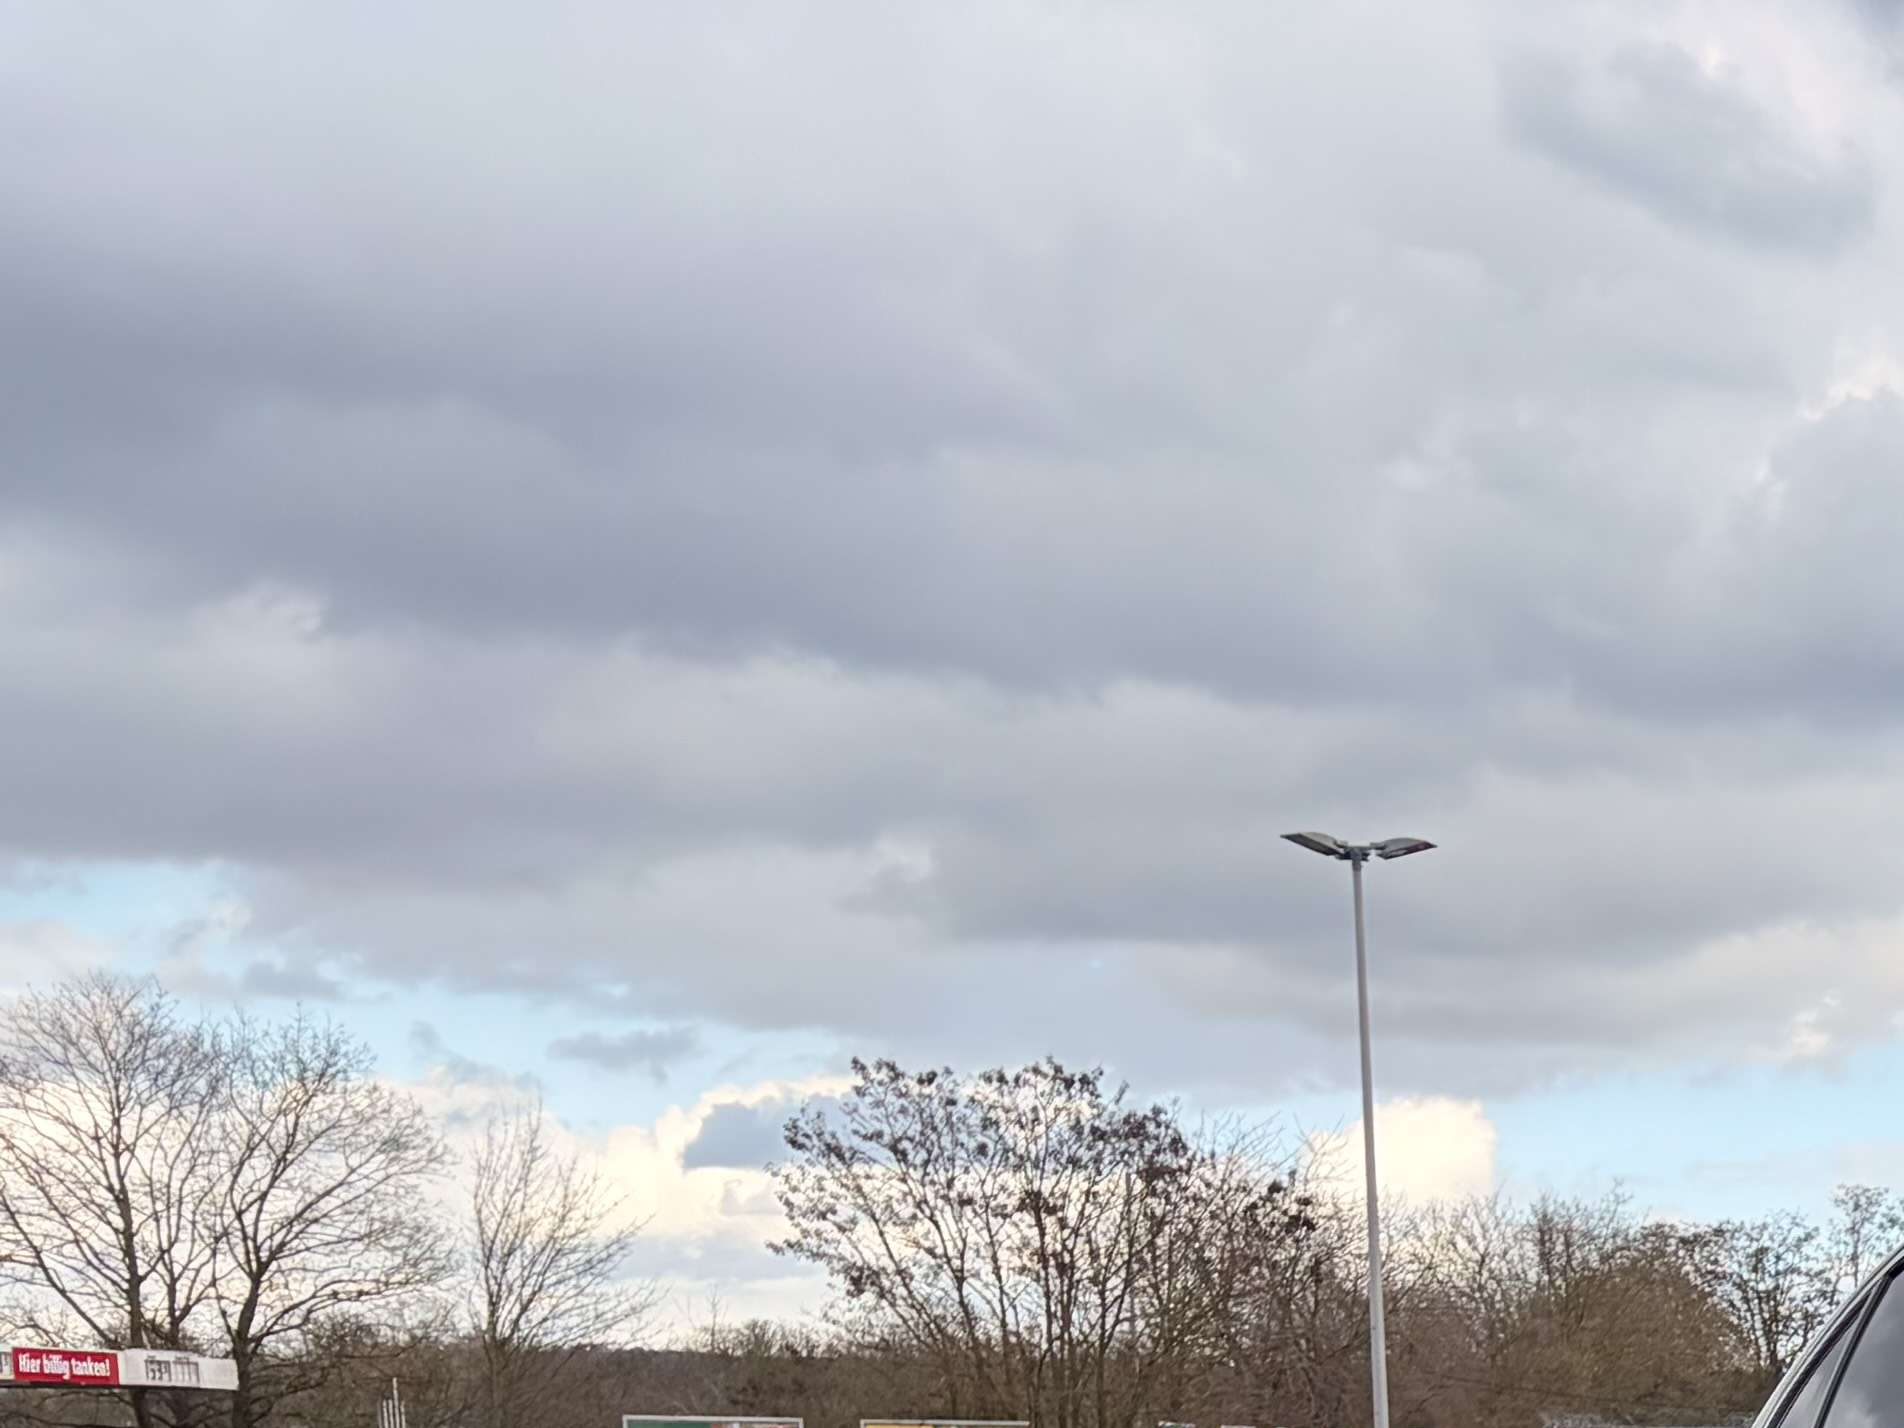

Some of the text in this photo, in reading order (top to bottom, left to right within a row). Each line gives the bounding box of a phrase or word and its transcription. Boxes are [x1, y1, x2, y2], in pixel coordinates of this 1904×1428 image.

[18, 1353, 40, 1374] Hier
[43, 1354, 69, 1380] billig
[72, 1357, 110, 1377] tanken!
